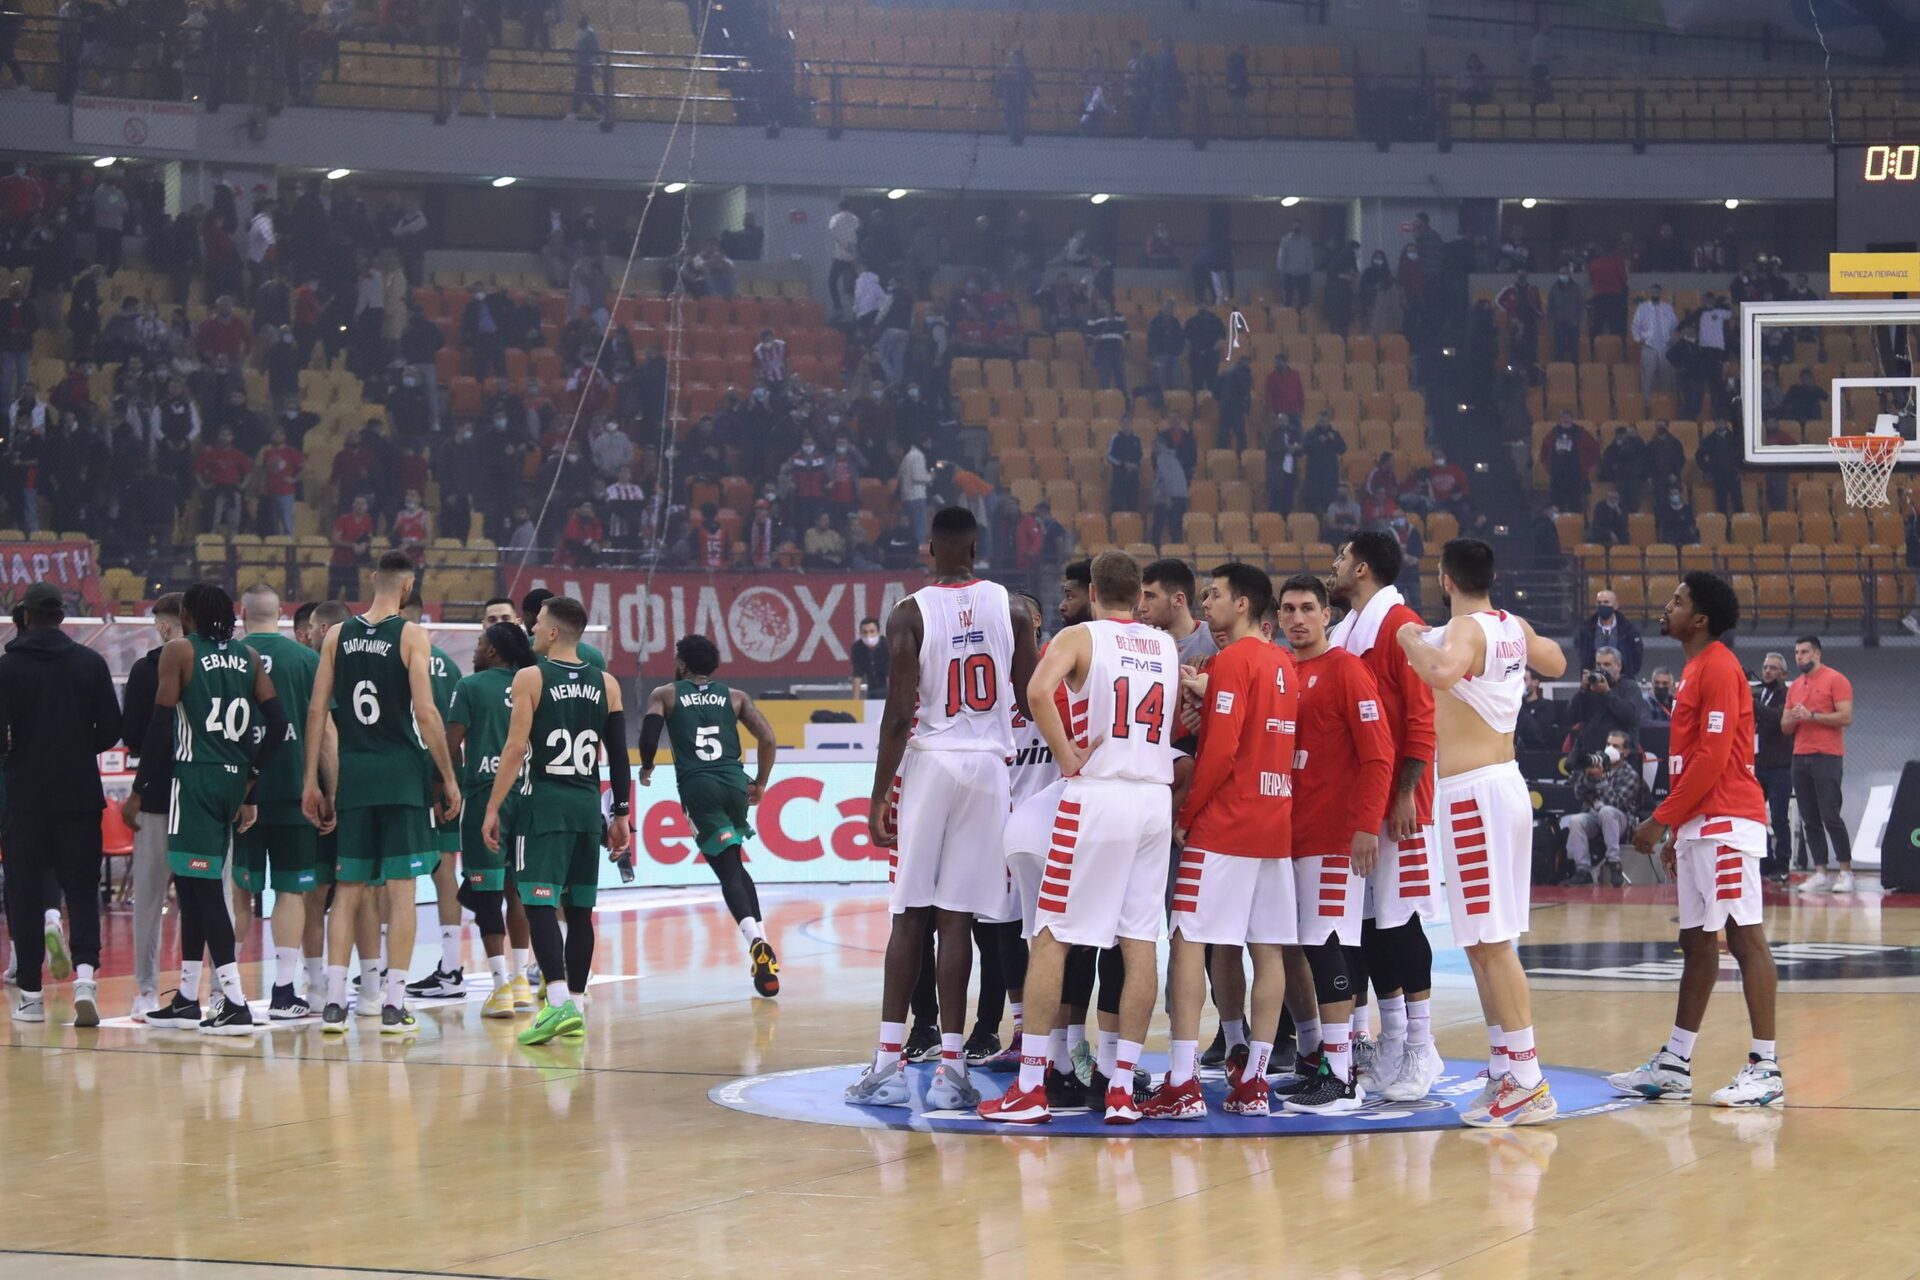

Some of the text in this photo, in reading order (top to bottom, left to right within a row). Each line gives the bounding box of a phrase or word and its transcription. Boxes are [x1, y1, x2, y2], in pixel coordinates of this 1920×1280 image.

[201, 653, 248, 673] ΕΒΑΝΣ
[1121, 656, 1162, 673] FMS
[945, 653, 998, 717] 10
[1276, 667, 1285, 694] 4
[353, 680, 380, 725] 6
[550, 684, 601, 704] ΝΕΜΑΝΙΑ
[1112, 676, 1165, 744] 14
[545, 728, 599, 776] 26
[695, 726, 723, 761] 5
[190, 860, 208, 869] AVIS
[534, 888, 552, 897] AVIS
[1336, 1043, 1349, 1053] GS
[1023, 1056, 1043, 1065] GSA
